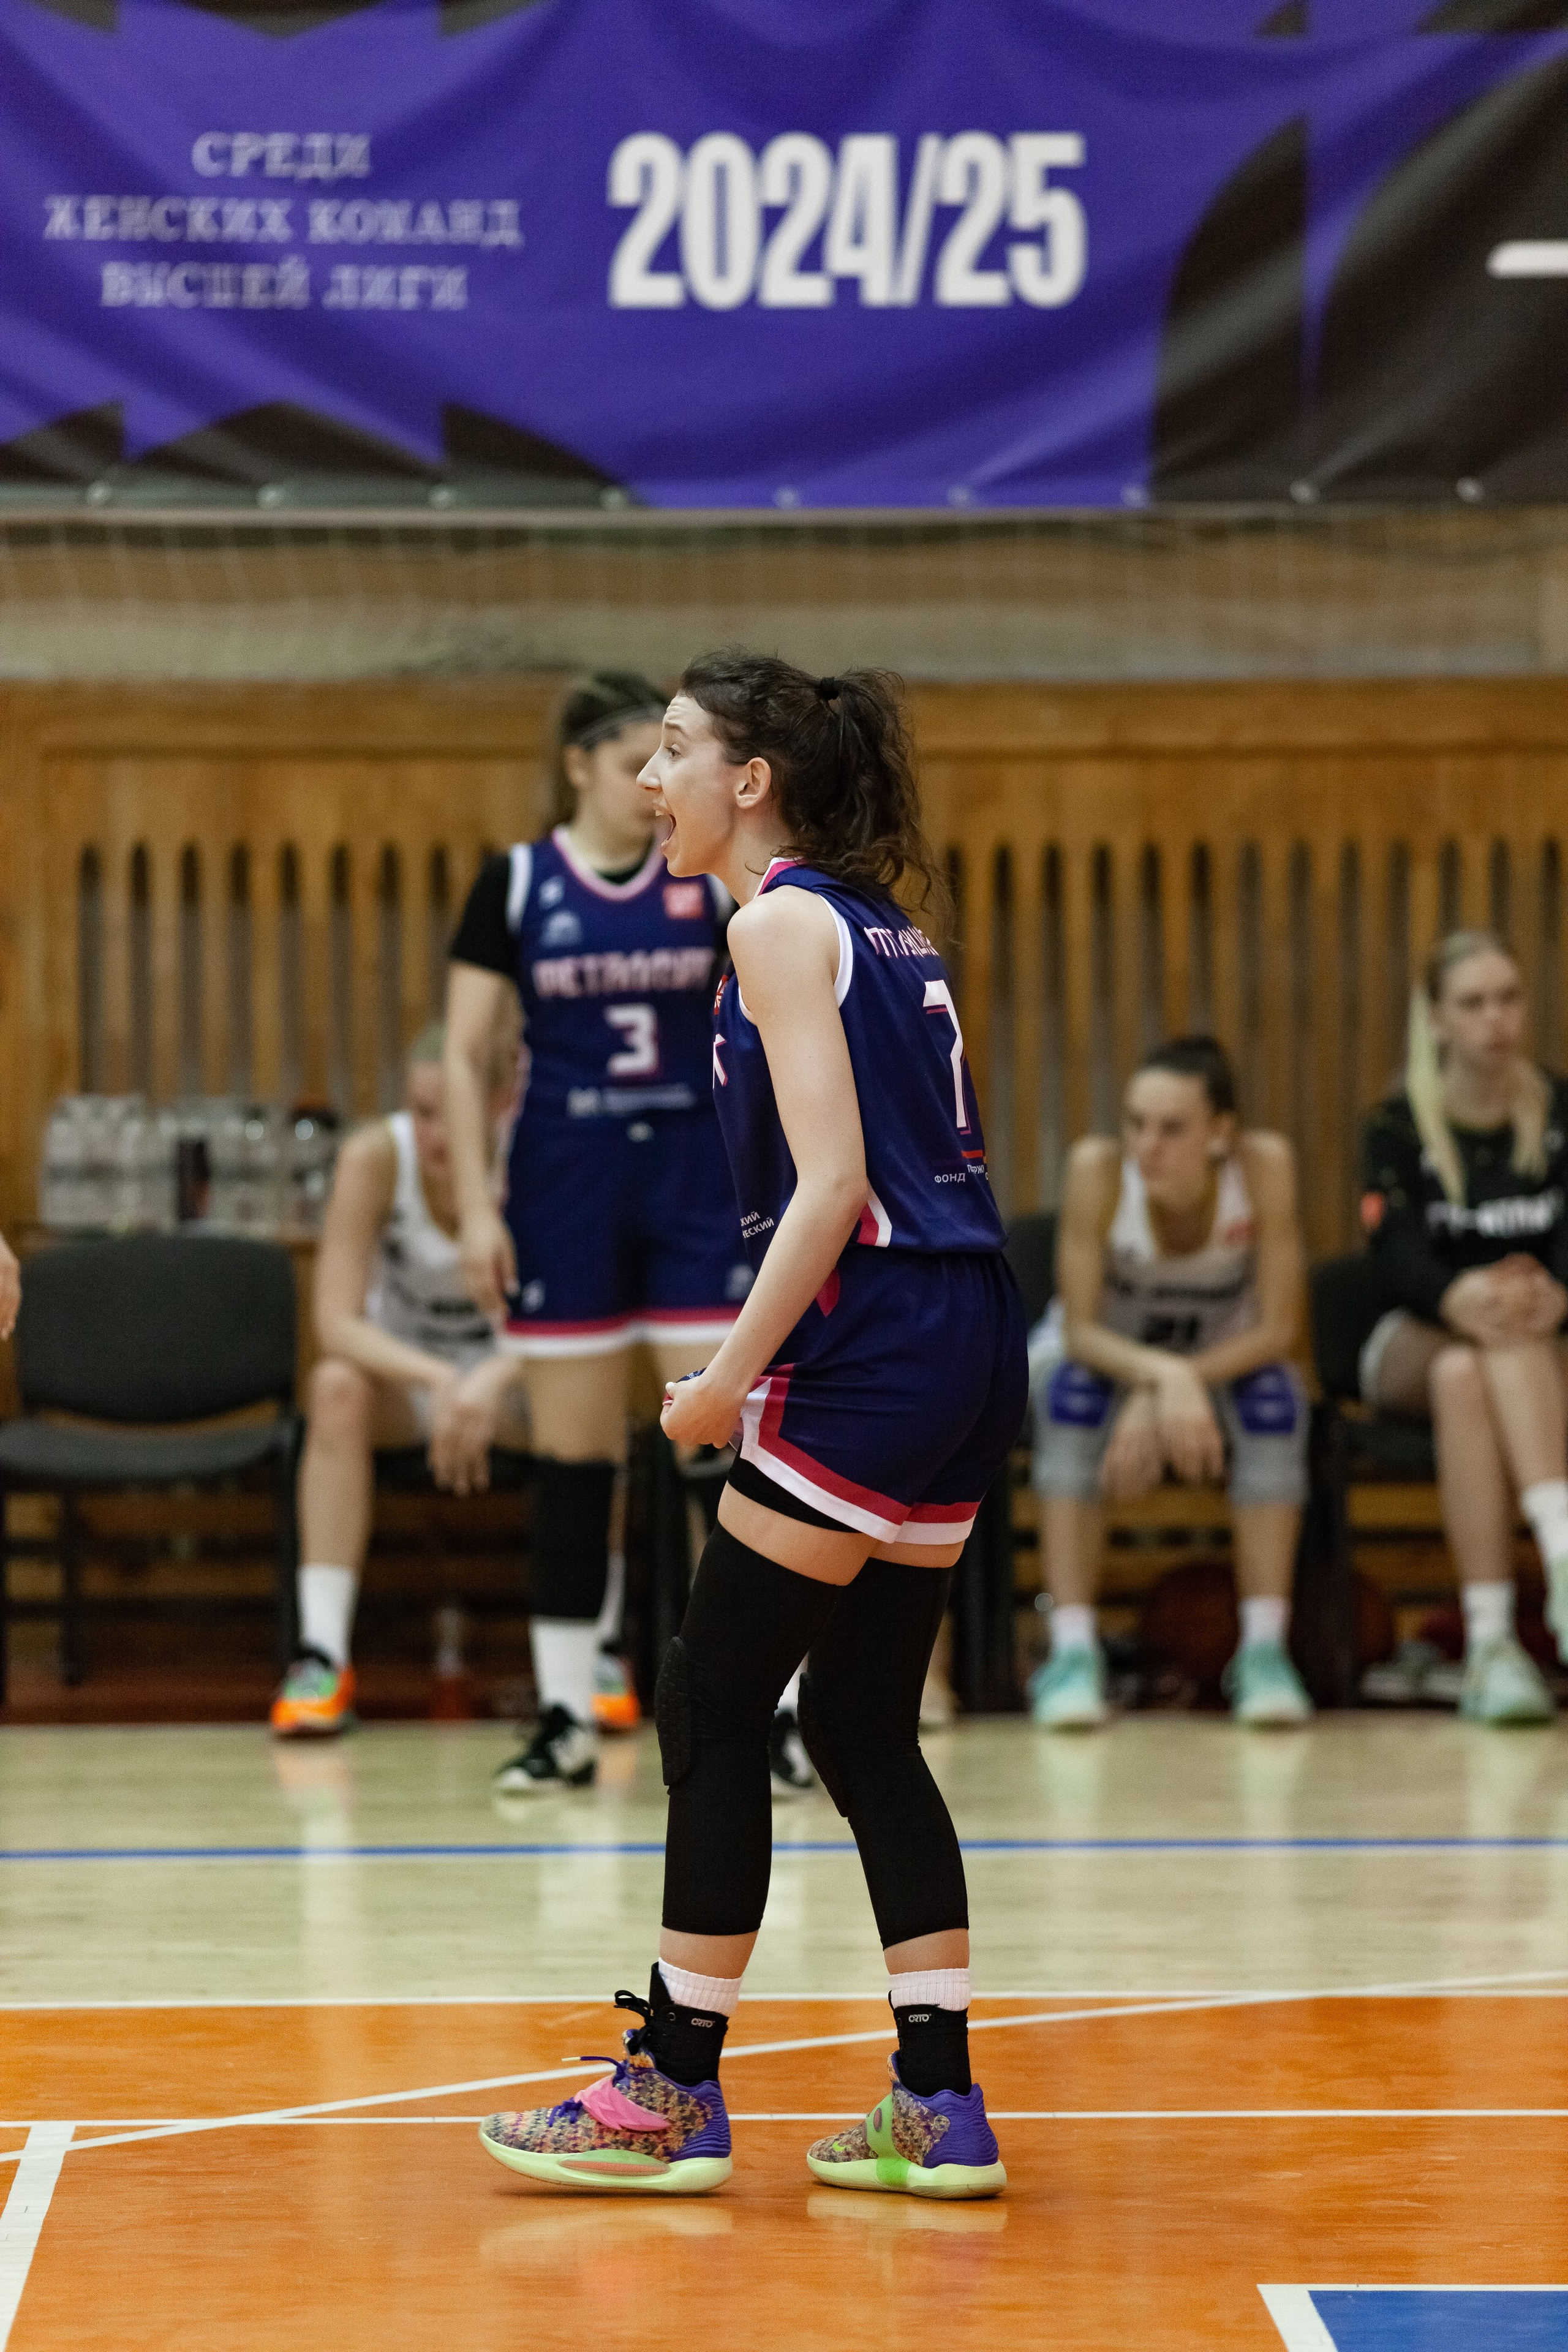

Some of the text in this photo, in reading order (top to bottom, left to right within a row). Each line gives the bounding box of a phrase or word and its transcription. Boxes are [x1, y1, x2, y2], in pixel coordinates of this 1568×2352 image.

[190, 132, 371, 183] СРЕДИ
[43, 194, 524, 252] ЖЕНСКИХ КОМАНД
[608, 130, 1087, 309] 2024/25
[100, 255, 468, 311] ВЫСШЕЙ ЛИГИ
[605, 1005, 658, 1076] 3
[923, 979, 971, 1134] 7
[934, 1172, 966, 1183] ФОНД
[740, 1210, 761, 1227] КИЙ
